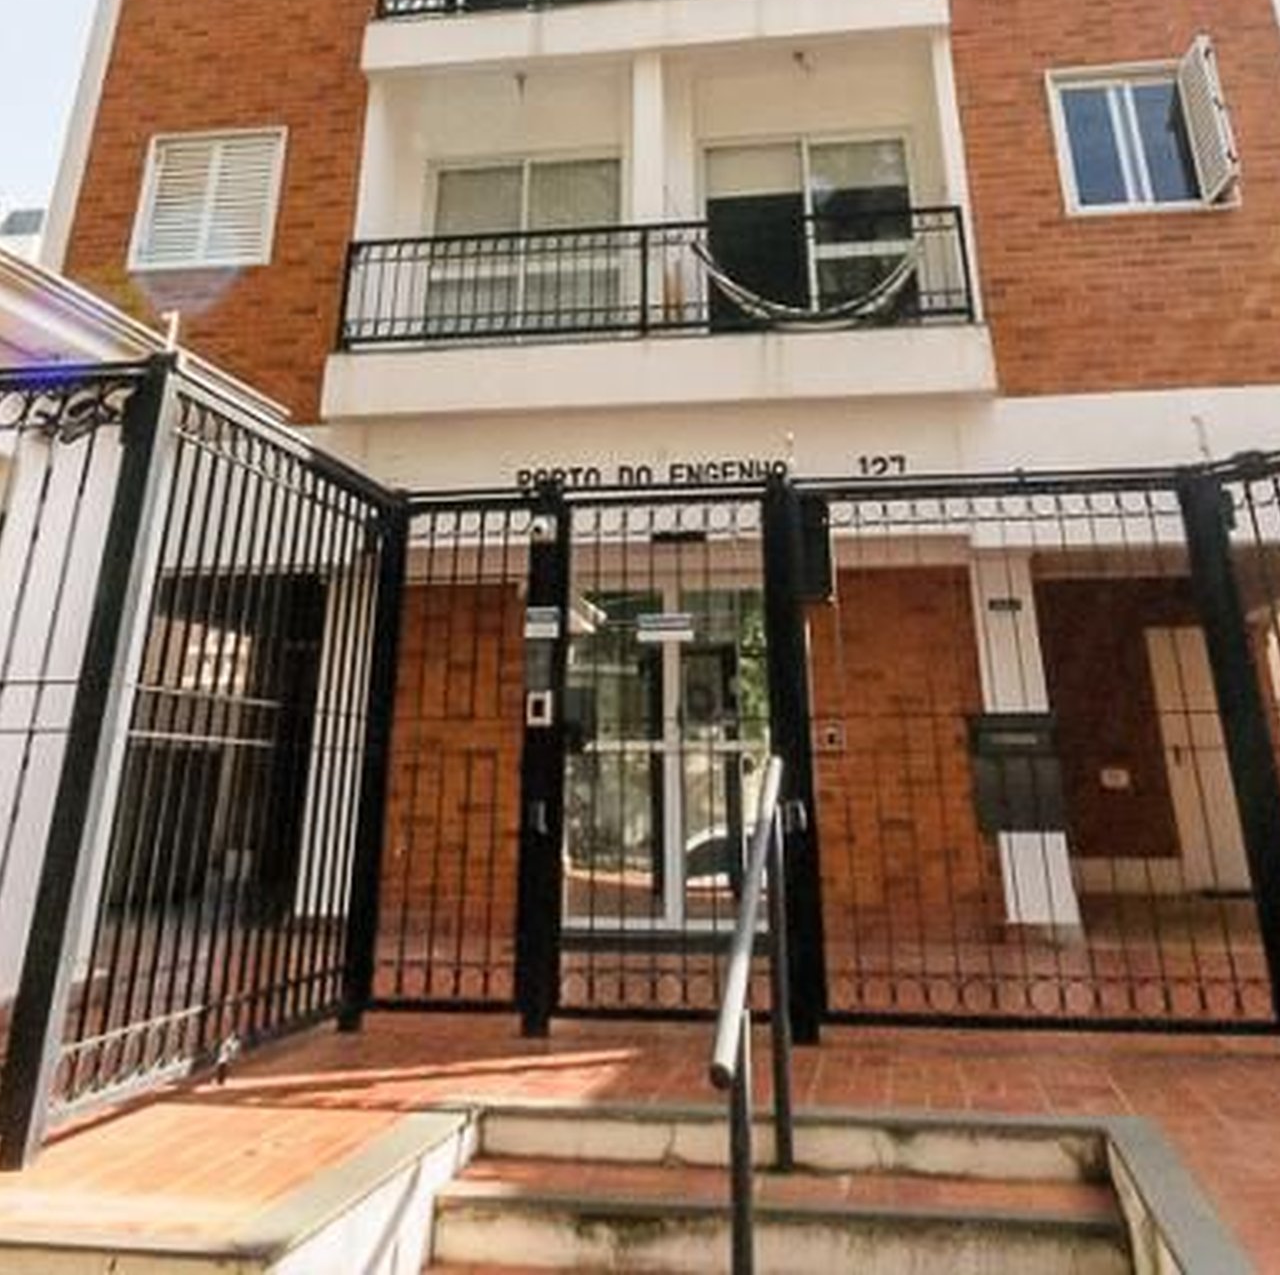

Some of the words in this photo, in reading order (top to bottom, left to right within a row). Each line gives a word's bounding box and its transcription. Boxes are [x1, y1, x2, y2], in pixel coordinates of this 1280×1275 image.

[618, 465, 651, 485] DO
[669, 460, 786, 483] ENGENHO
[858, 455, 906, 475] 127
